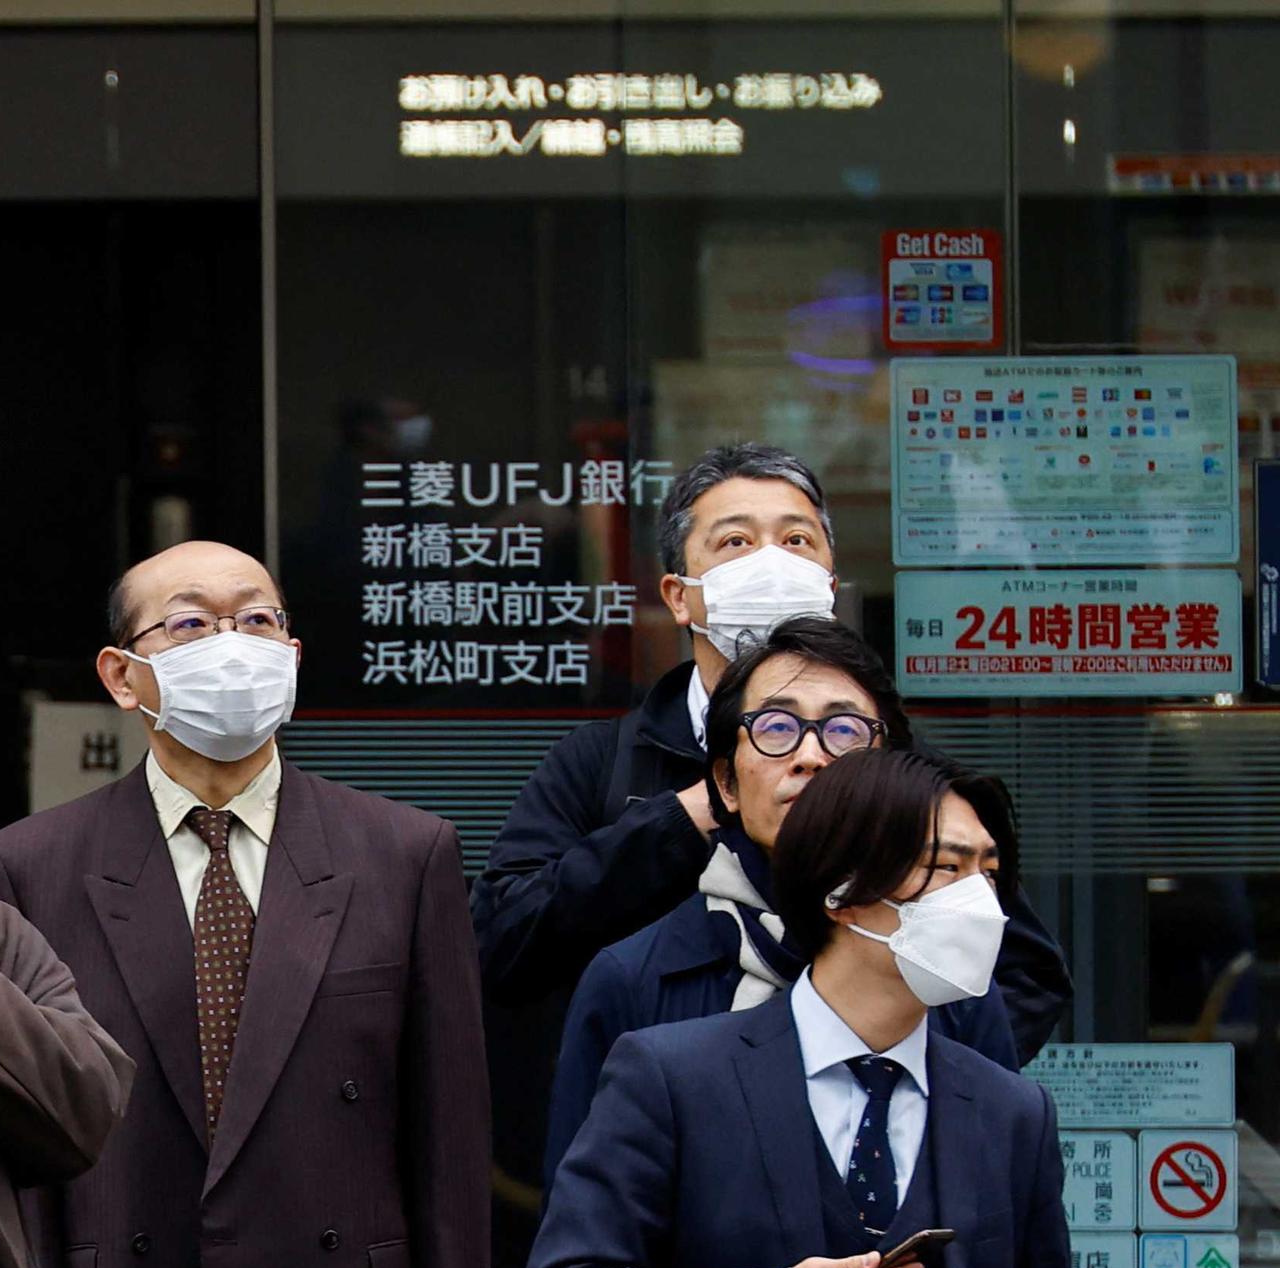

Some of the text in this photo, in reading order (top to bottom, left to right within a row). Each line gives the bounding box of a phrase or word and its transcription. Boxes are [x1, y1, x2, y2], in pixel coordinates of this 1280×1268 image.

[896, 232, 985, 256] Get Cash
[360, 459, 676, 508] 三菱UFJ銀行
[361, 522, 544, 569] 新橋支店
[361, 580, 637, 627] 新橋駅前支店
[906, 603, 1220, 650] 毎日 24時間営業
[361, 639, 591, 685] 浜松町支店
[80, 732, 120, 772] 出
[1072, 1161, 1112, 1178] POLICE
